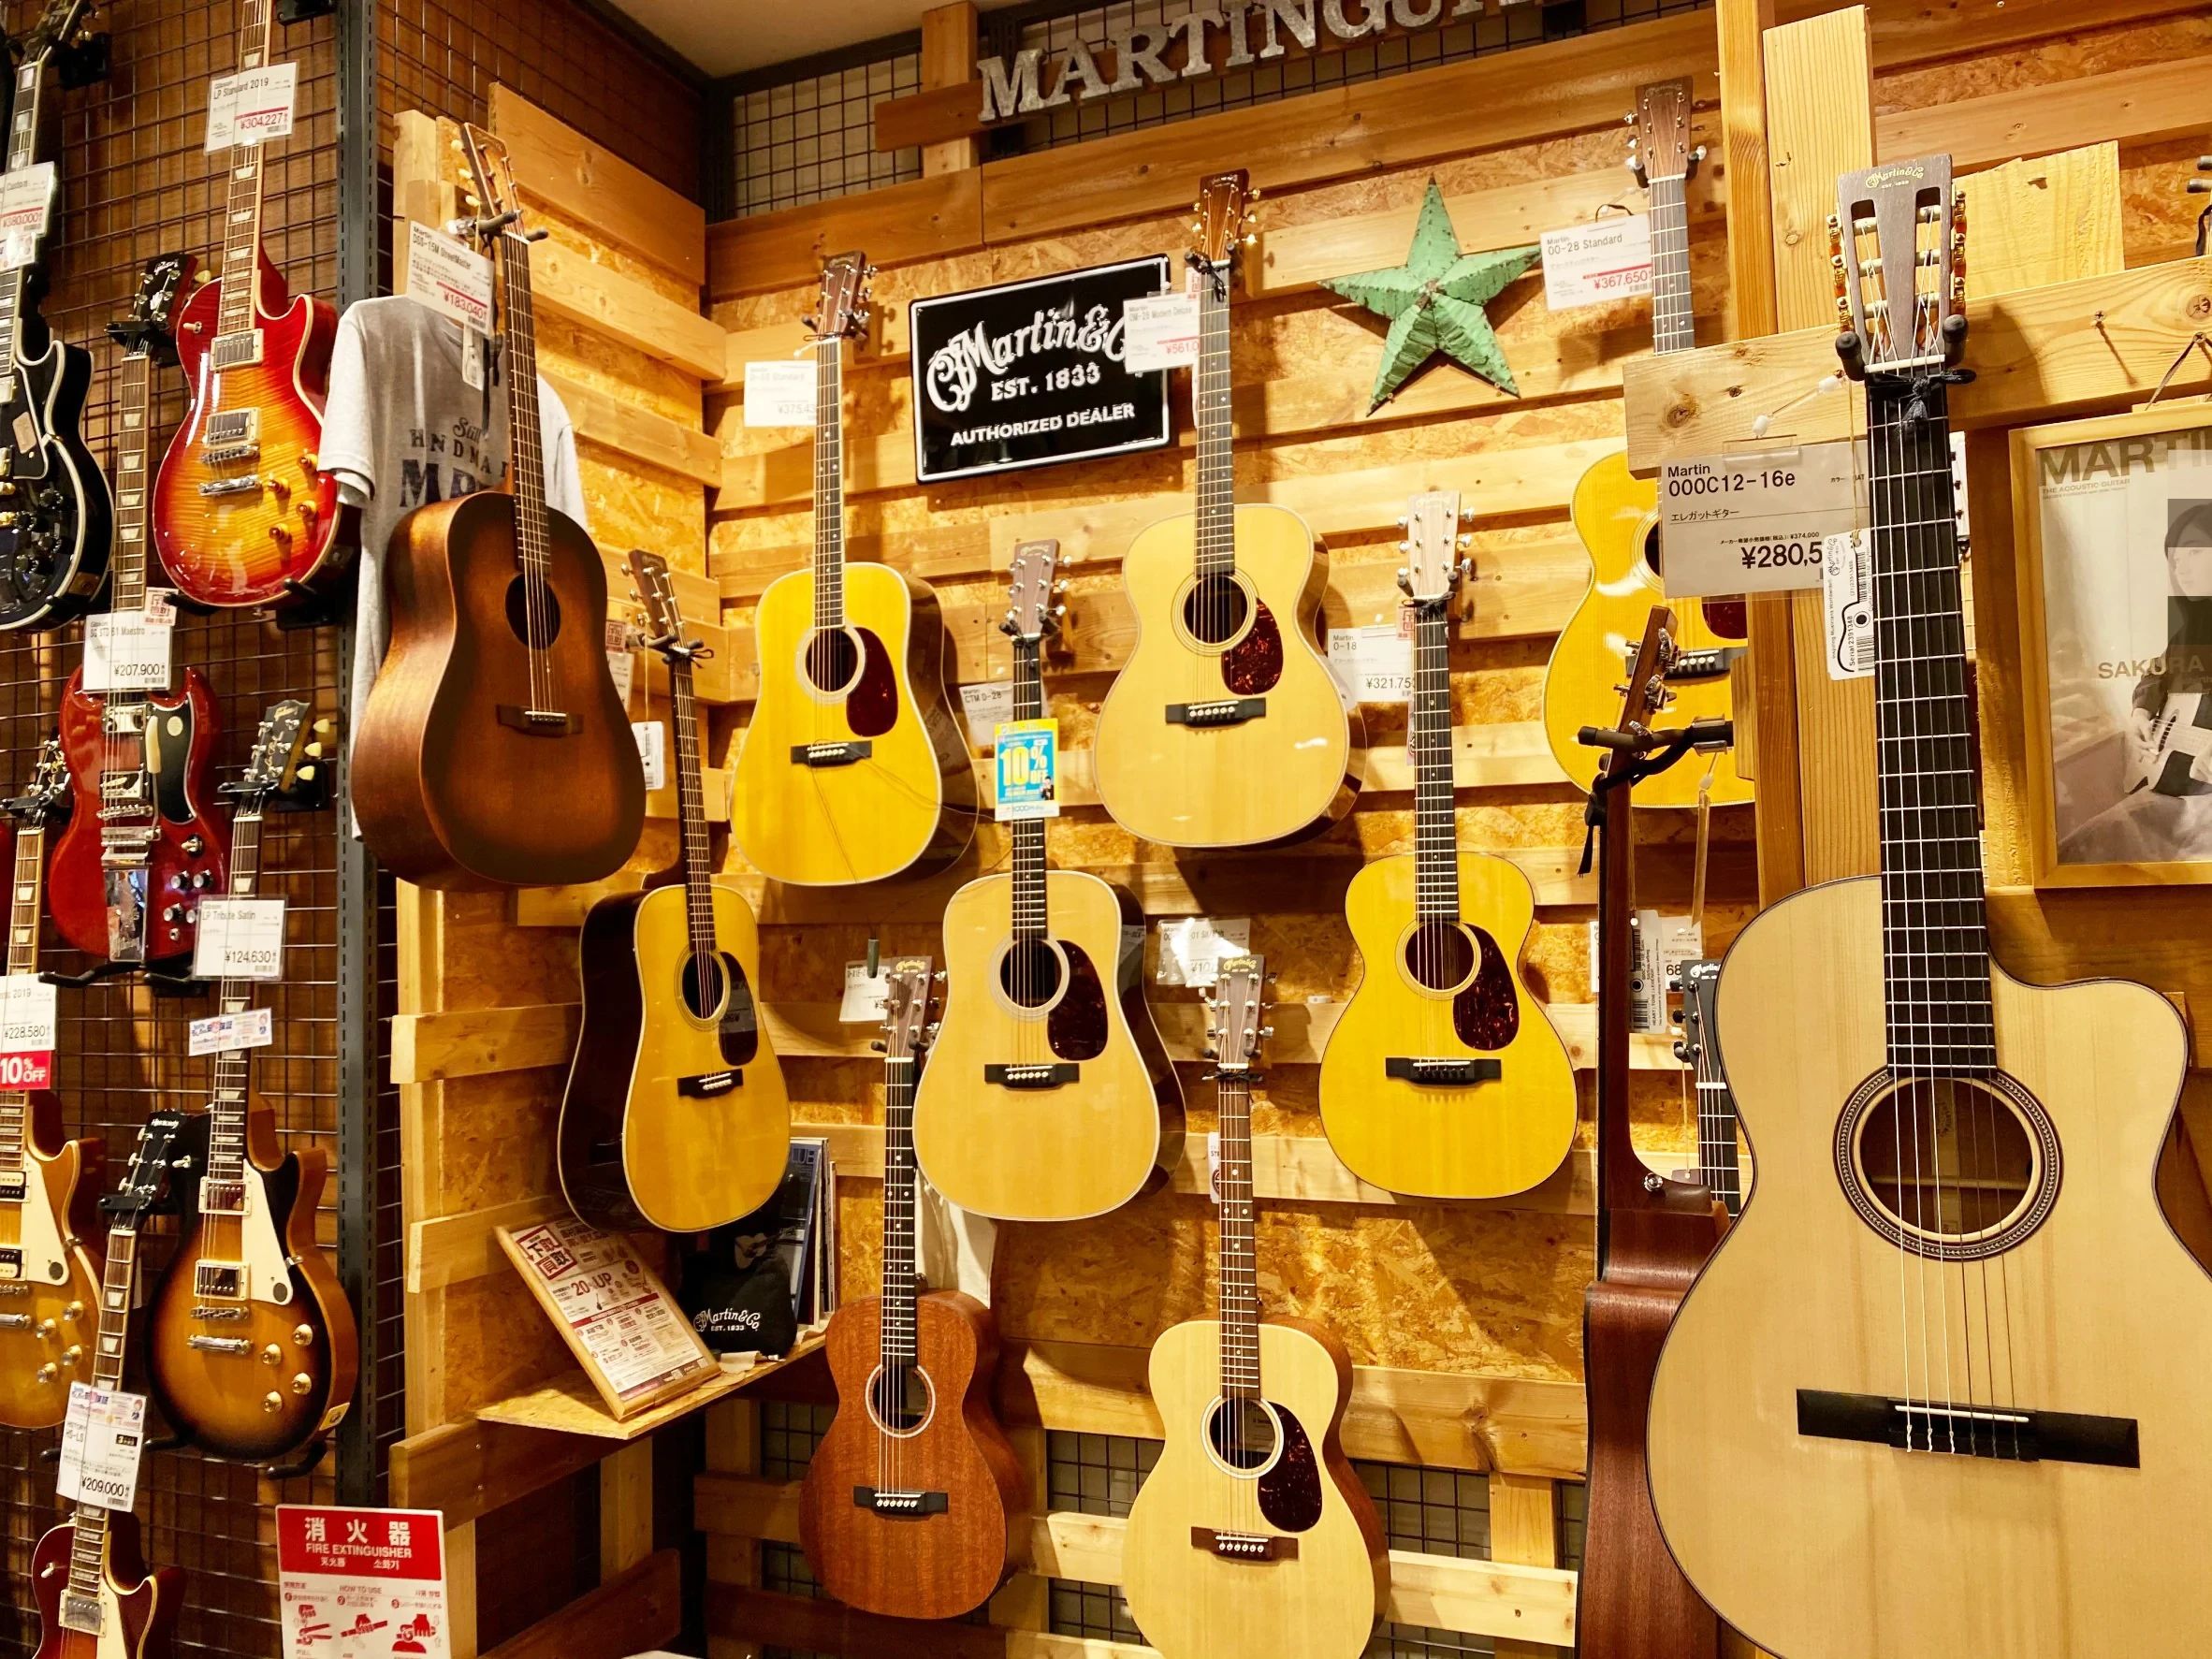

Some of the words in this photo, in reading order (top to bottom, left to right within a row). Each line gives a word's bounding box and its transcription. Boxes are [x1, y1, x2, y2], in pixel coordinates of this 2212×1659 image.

[250, 77, 269, 89] 2019
[1548, 242, 1580, 255] 00-28
[1582, 234, 1623, 250] Standard
[990, 374, 1039, 402] EST.
[1045, 361, 1101, 391] 1833
[950, 415, 1063, 446] AUTHORIZED
[1066, 402, 1136, 429] DEALER
[1667, 463, 1710, 478] Martin
[1668, 470, 1796, 497] 000C12-16e
[1670, 508, 1740, 523] エレガットギター
[2098, 655, 2205, 679] SAKURA
[22, 1070, 47, 1084] OFF
[304, 1516, 412, 1548] 消火器
[305, 1542, 330, 1555] FIRE
[332, 1544, 413, 1560] EXTINGUISHER
[339, 1585, 357, 1594] HOW
[357, 1585, 367, 1594] TO
